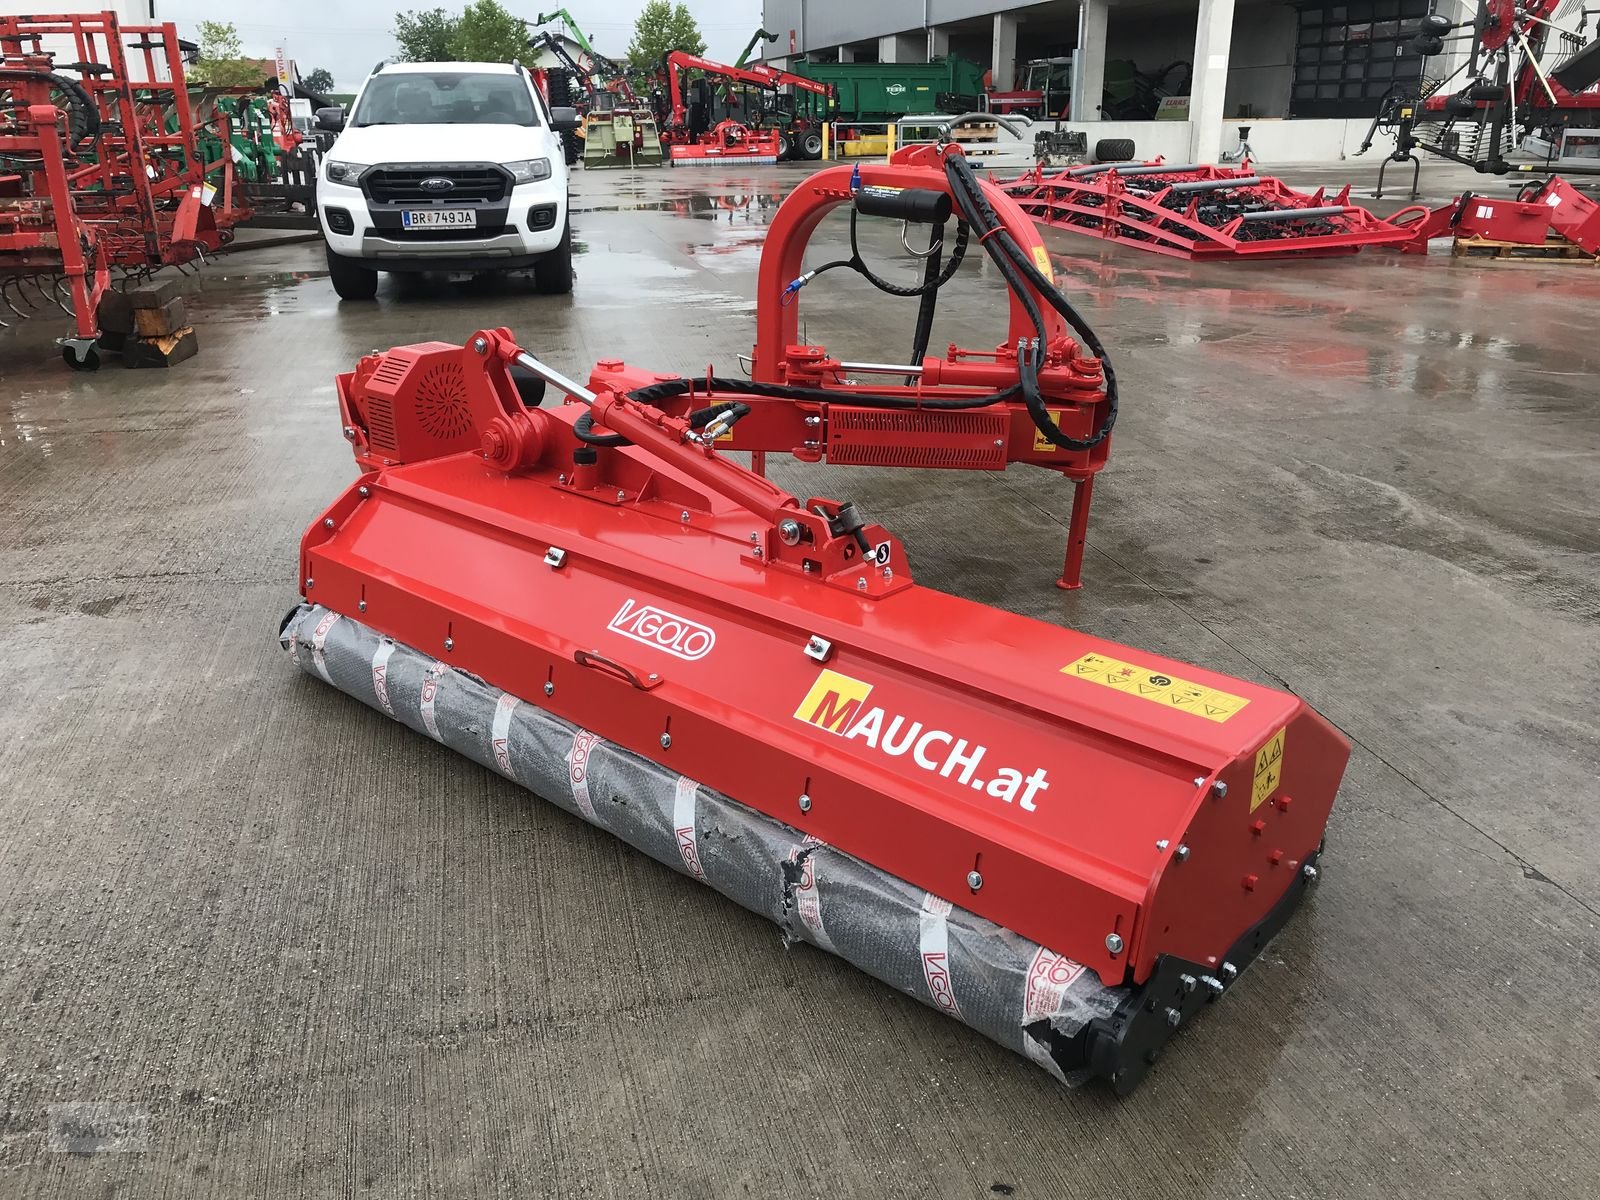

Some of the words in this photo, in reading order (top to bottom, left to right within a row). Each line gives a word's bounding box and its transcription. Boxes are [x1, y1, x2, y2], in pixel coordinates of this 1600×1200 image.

[412, 212, 426, 224] BR
[607, 598, 716, 660] VIGOLO
[804, 685, 1050, 812] MAUCH.at
